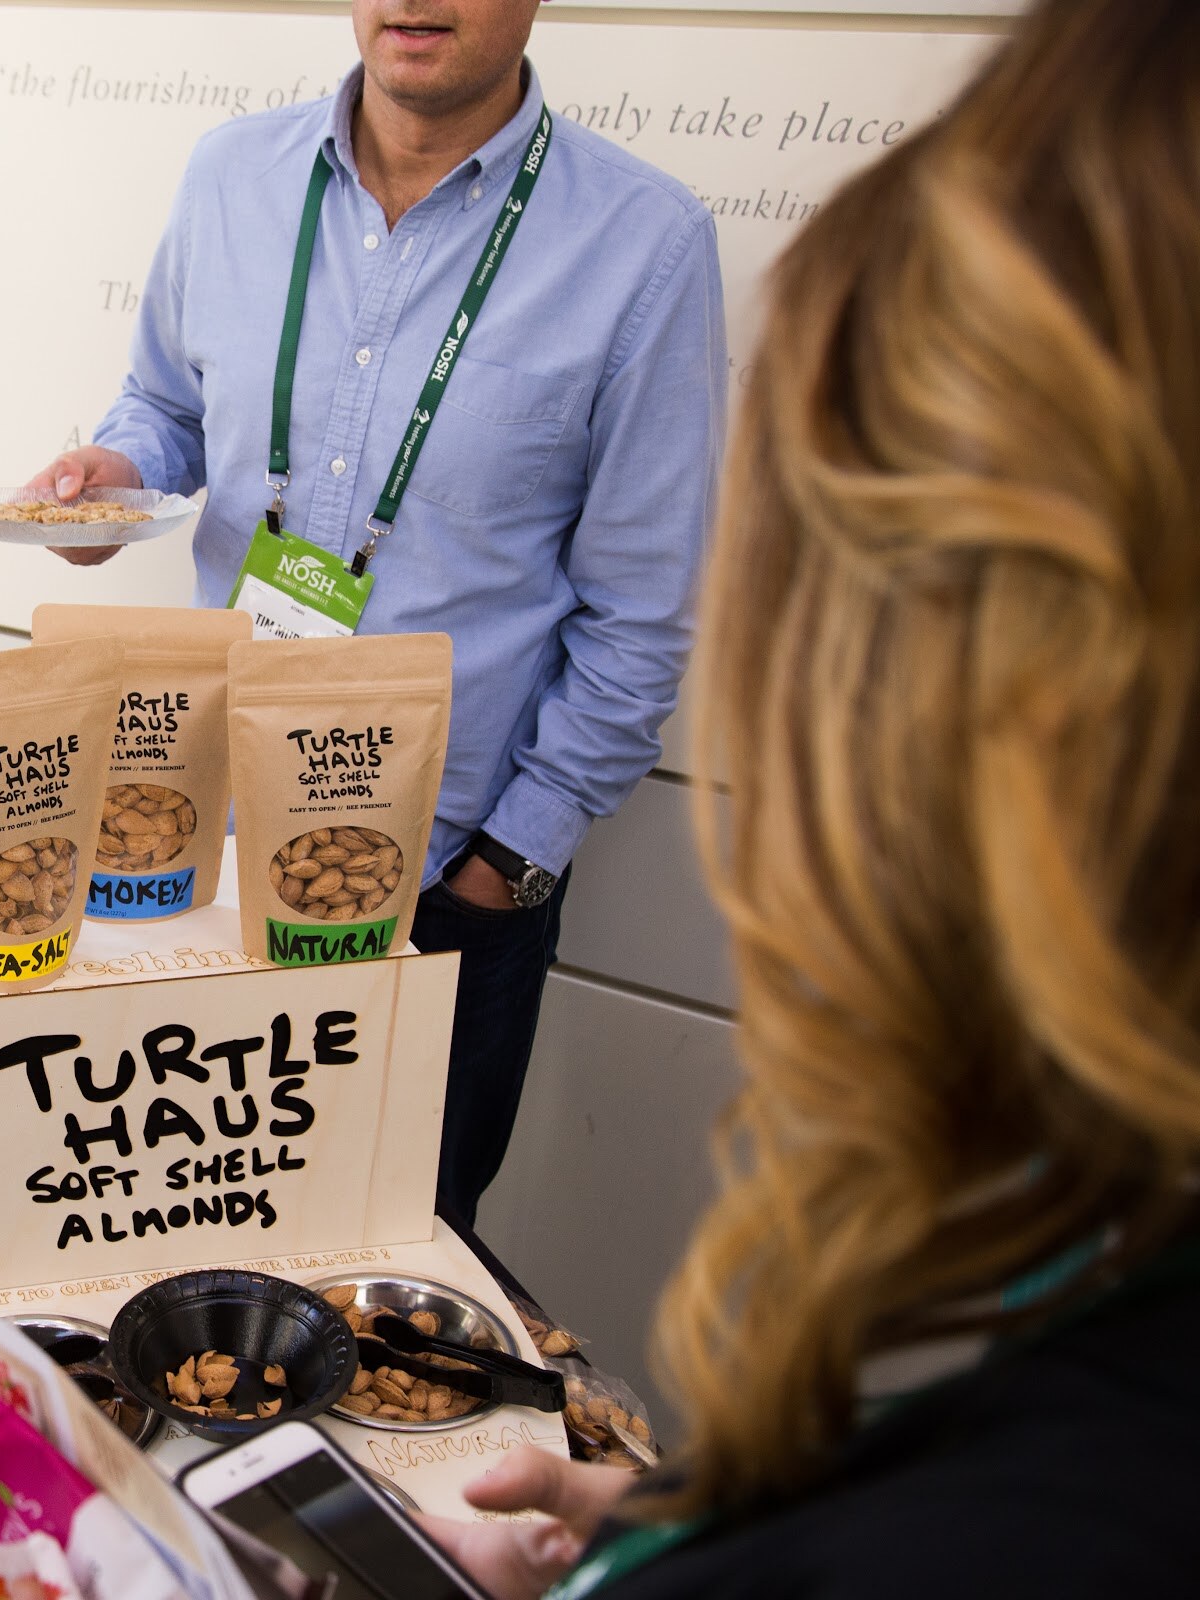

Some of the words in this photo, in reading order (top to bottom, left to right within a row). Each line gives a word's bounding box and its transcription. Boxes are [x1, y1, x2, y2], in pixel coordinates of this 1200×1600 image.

[67, 65, 250, 116] flourishing
[266, 76, 308, 110] of
[561, 92, 652, 142] only
[669, 97, 762, 138] take
[777, 102, 906, 151] place
[523, 132, 548, 175] NOSH
[690, 186, 821, 222] ranklin
[99, 280, 140, 313] Th
[431, 336, 460, 382] NOSH
[277, 554, 337, 597] NOSH
[255, 612, 275, 631] TIM
[118, 691, 190, 716] RTLE
[111, 747, 168, 760] LMONDS
[114, 734, 128, 746] FT
[135, 734, 176, 746] SHELL
[286, 726, 394, 755] TURTLE
[5, 757, 71, 790] HAUS
[155, 764, 186, 772] FRIENDLY
[308, 747, 382, 773] HAUS
[33, 779, 69, 797] SHELL
[298, 772, 331, 786] SOFT
[338, 769, 380, 784] SHELL
[307, 784, 373, 801] ALMONDS
[6, 794, 63, 819] ALMONDS
[16, 820, 32, 830] OPEN
[52, 809, 77, 822] FRIENDLY
[288, 806, 307, 814] EASY
[360, 802, 393, 810] FRIENDLY
[88, 870, 194, 908] MOKEY!
[268, 921, 391, 963] NATURAL
[64, 1077, 316, 1165] HAUS
[25, 1165, 140, 1204] SOFT
[165, 1144, 306, 1190] SHELL
[57, 1188, 278, 1250] ALMONDS
[17, 1285, 55, 1302] TO
[60, 1275, 132, 1298] OPEN
[368, 1421, 565, 1477] NATURAL
